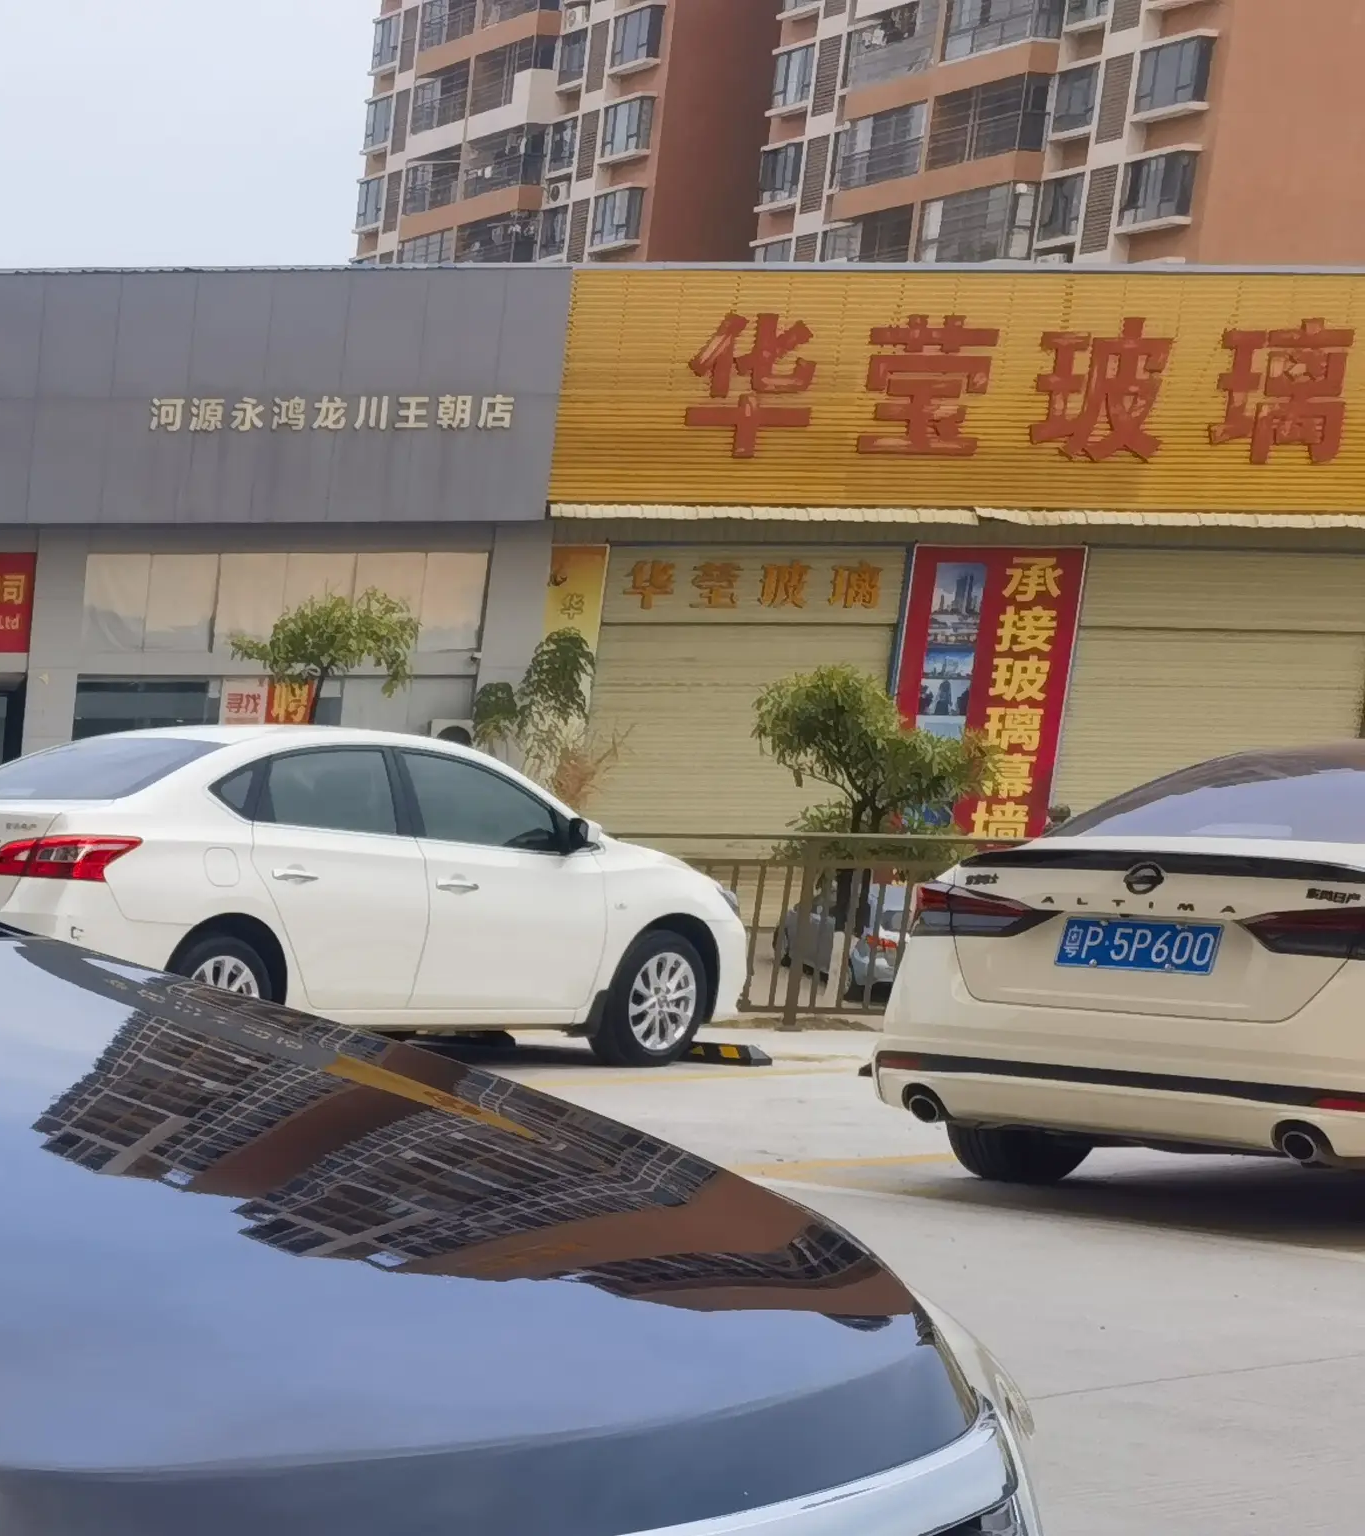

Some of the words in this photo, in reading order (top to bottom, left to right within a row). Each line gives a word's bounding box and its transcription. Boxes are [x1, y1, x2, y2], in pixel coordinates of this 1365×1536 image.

[149, 394, 516, 432] 河源永鸿龙川王朝店
[683, 312, 1355, 464] 华莹玻璃
[623, 559, 882, 611] 华莹玻璃
[970, 556, 1064, 839] 承接玻璃幕墙
[1041, 895, 1236, 914] ALTIMA
